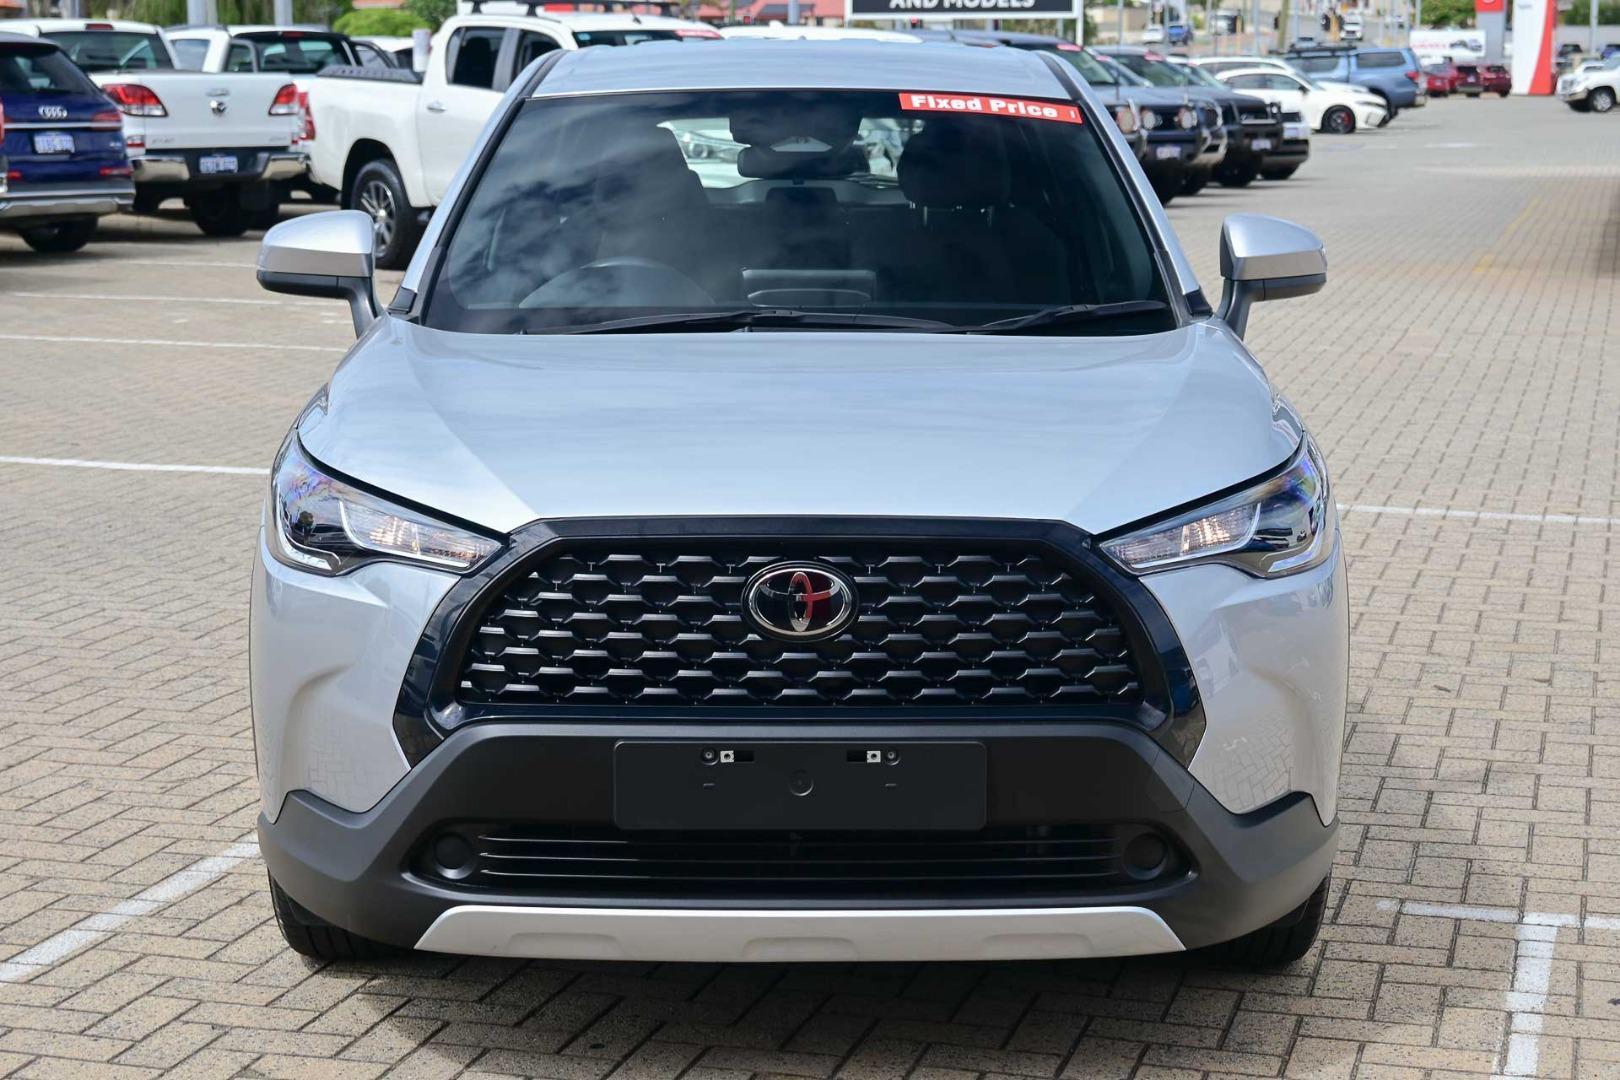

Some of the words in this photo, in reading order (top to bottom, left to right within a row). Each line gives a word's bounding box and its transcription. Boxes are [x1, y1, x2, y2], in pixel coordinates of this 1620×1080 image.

[889, 0, 937, 9] AND
[943, 0, 1035, 9] MODELS
[911, 95, 983, 111] Fixed
[990, 97, 1058, 118] Price
